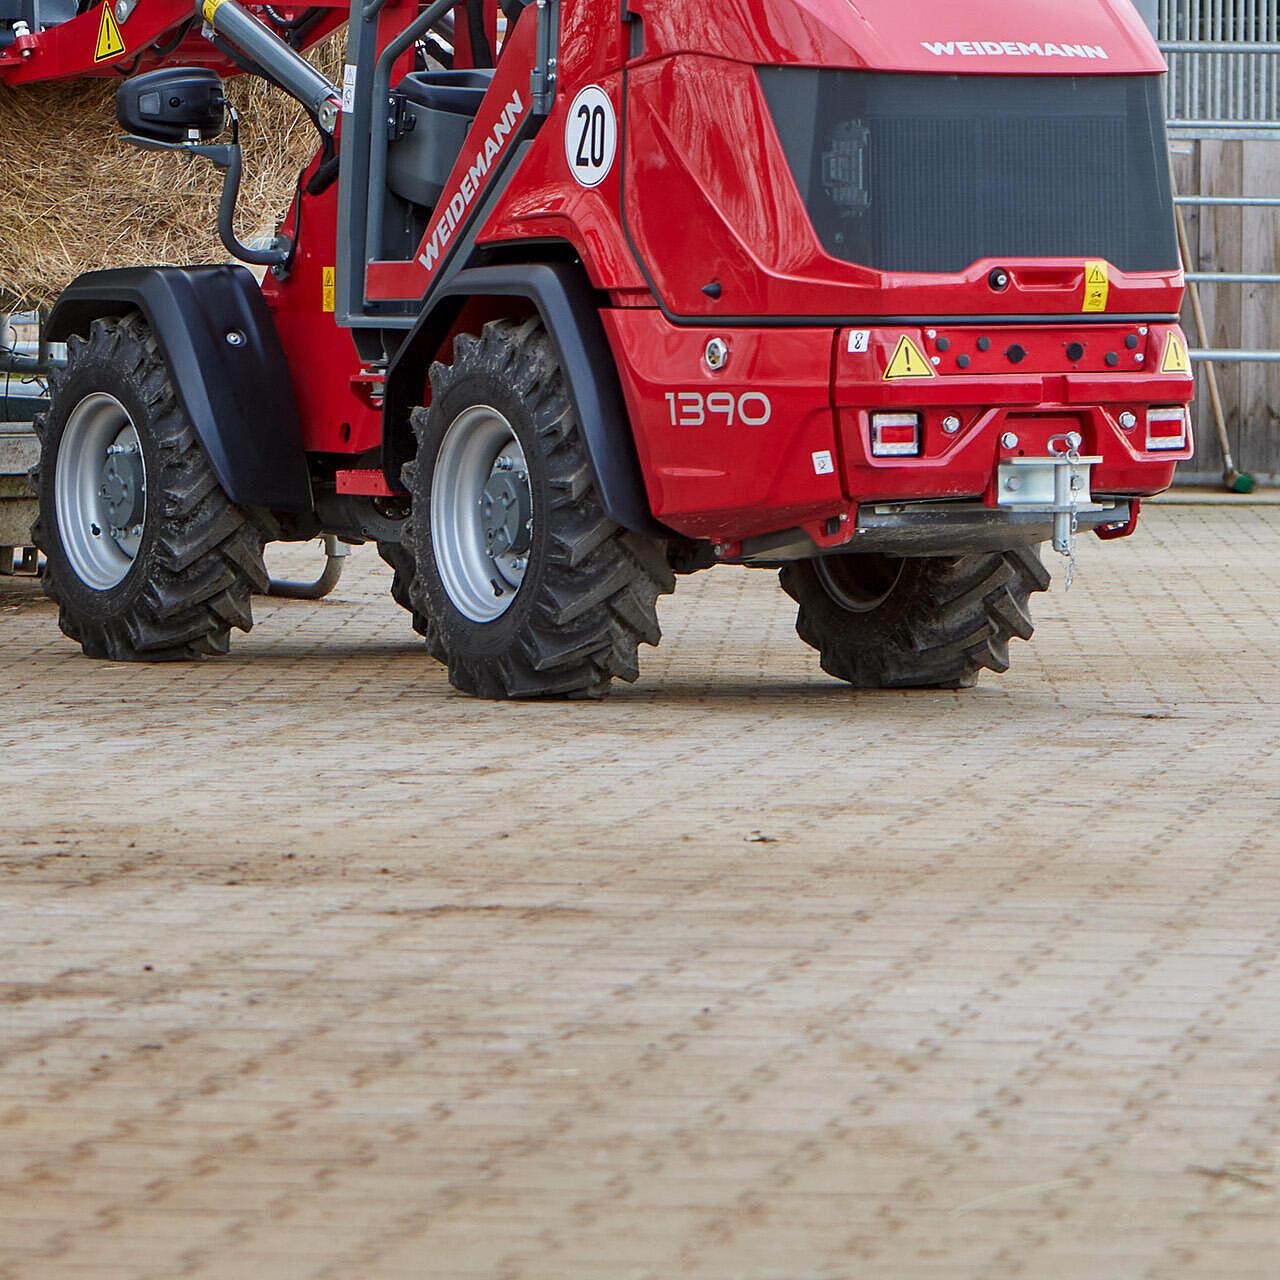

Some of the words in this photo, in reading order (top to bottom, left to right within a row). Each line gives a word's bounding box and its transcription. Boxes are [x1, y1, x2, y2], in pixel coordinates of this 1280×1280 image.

[920, 41, 1109, 60] WEIDEMANN
[576, 104, 606, 168] 20
[418, 89, 524, 271] WEIDEMANN
[664, 391, 772, 426] 1390
